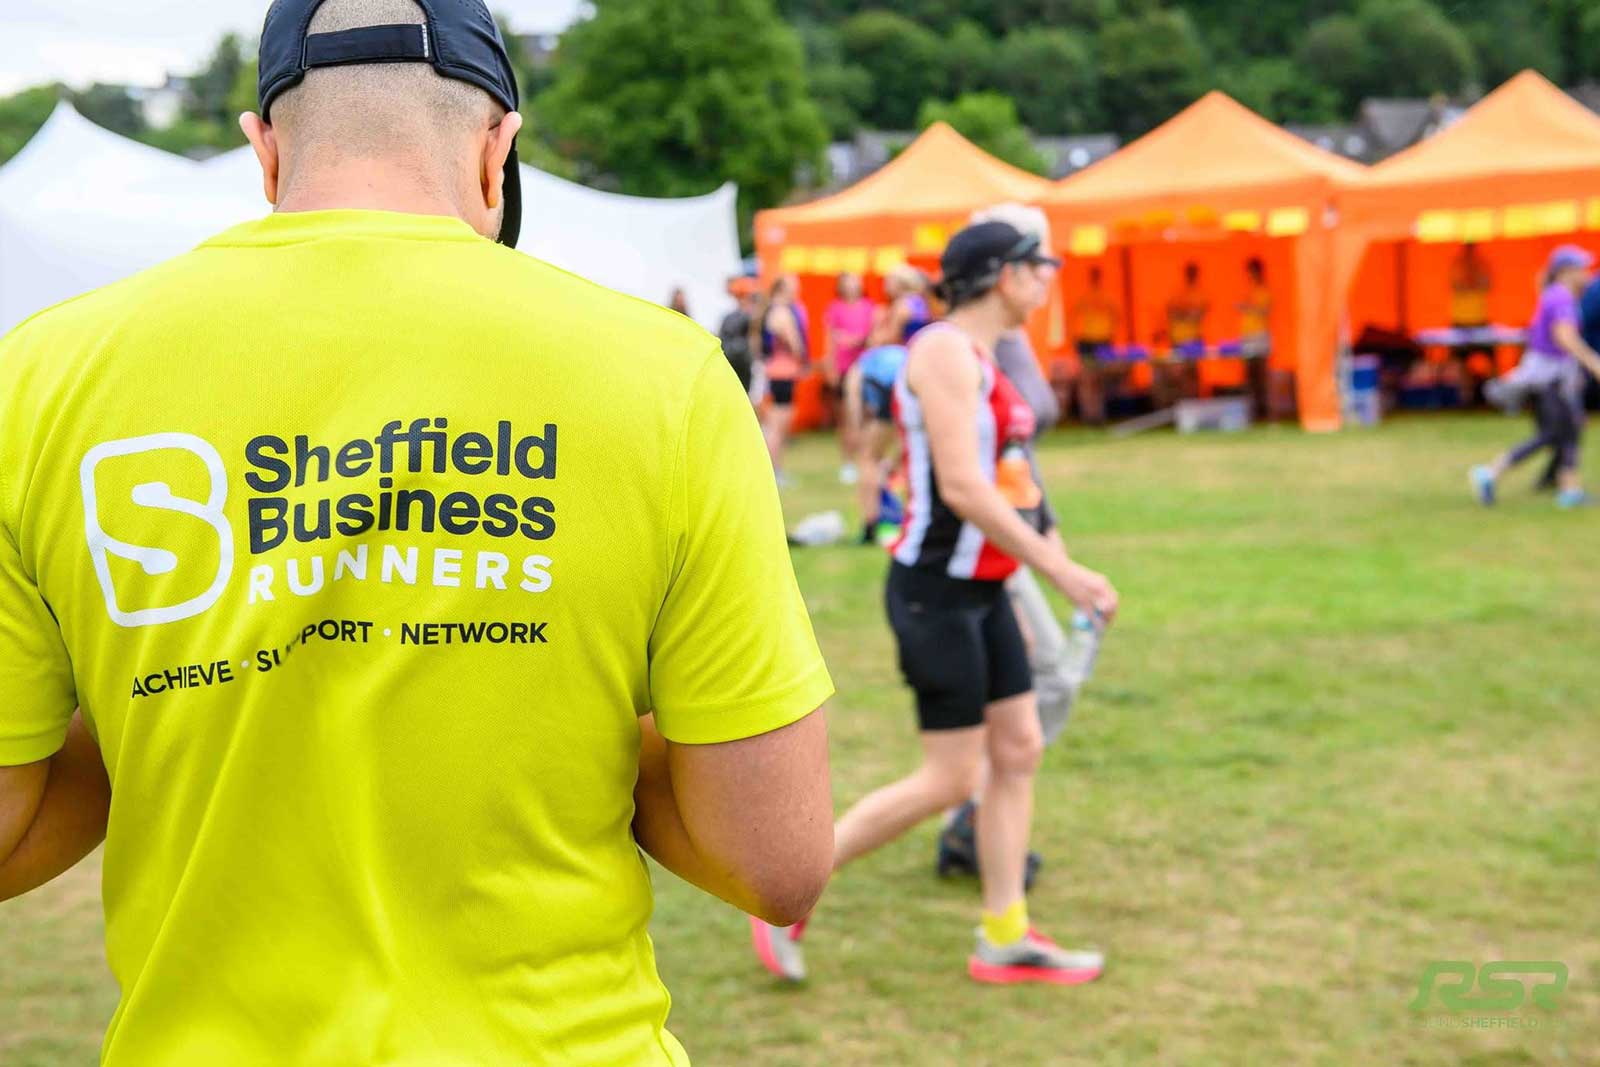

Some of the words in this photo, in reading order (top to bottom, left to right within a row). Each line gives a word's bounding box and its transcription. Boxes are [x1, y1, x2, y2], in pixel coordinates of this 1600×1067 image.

[244, 417, 558, 494] Sheffield
[247, 477, 556, 555] Business
[246, 544, 553, 607] RUNNERS
[131, 660, 234, 699] ACHIEVE
[256, 619, 374, 673] SPORT
[400, 622, 548, 645] NETWORK
